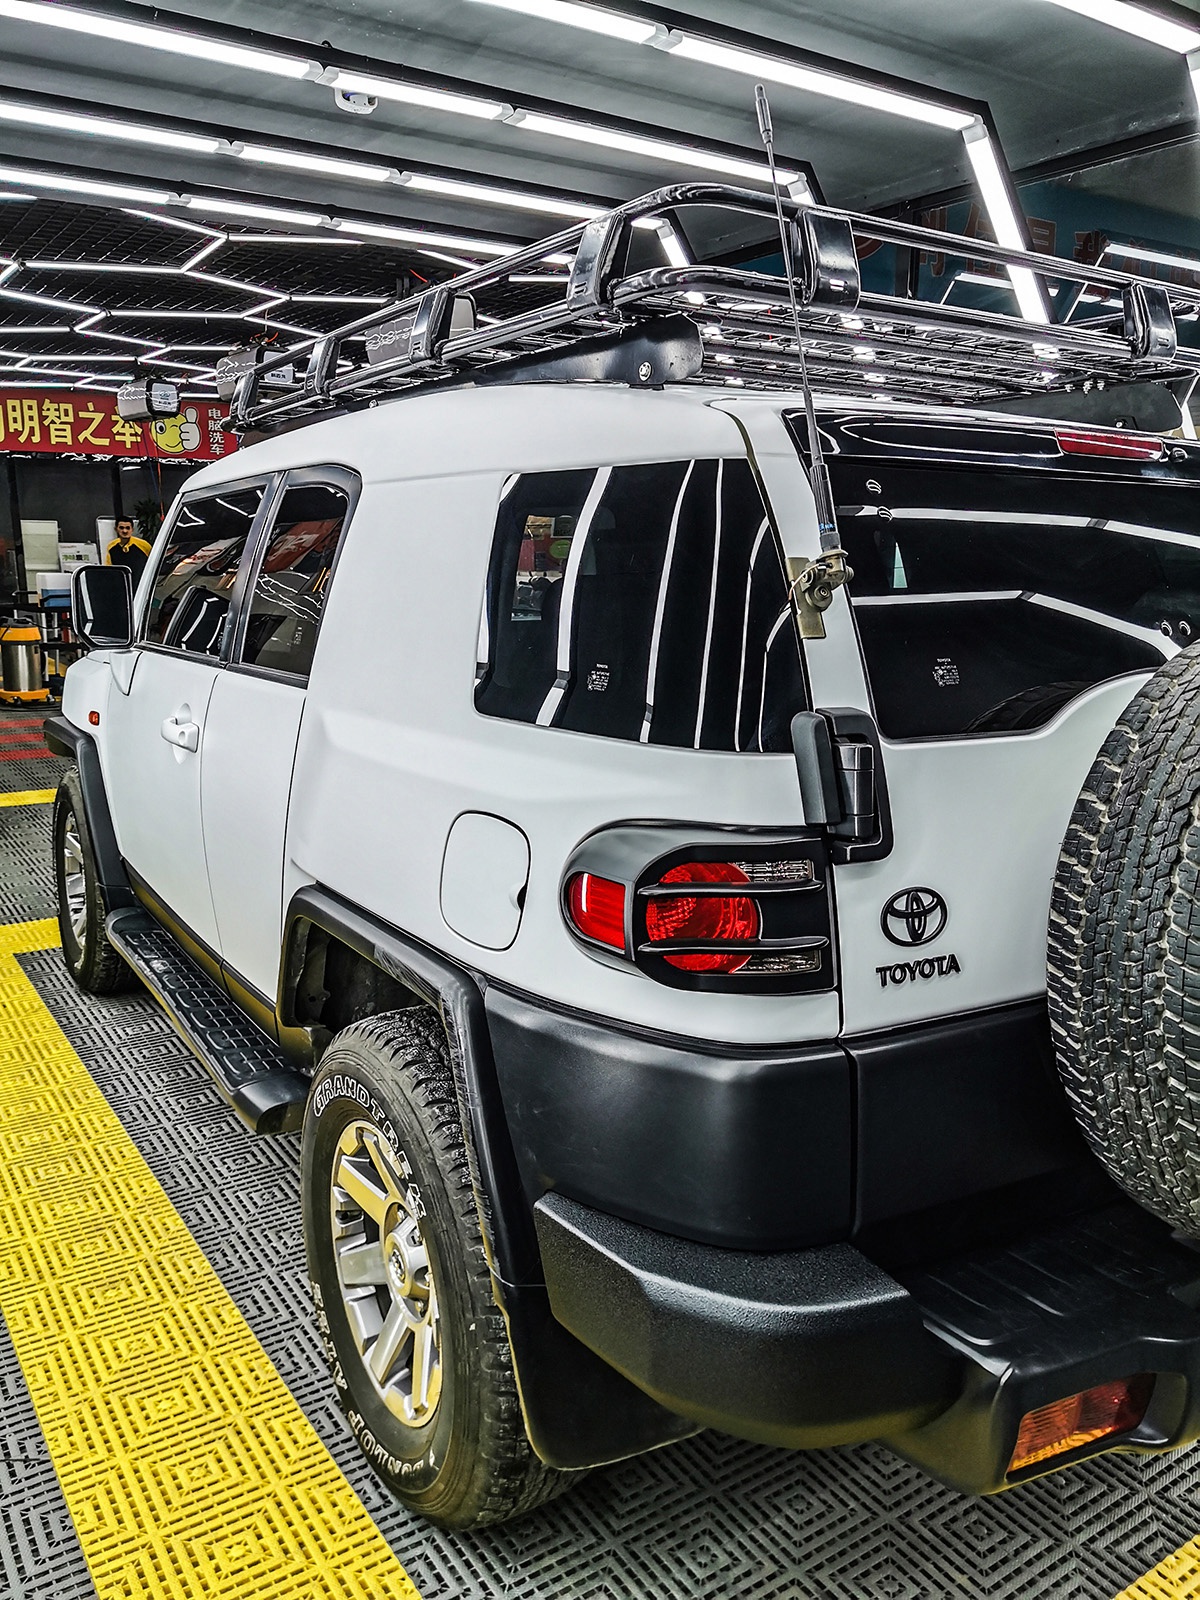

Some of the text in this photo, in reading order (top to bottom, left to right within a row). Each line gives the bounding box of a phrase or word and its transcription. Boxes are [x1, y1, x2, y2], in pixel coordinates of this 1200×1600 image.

[0, 399, 143, 449] 明智之举
[208, 407, 225, 455] 电脑洗车
[875, 954, 962, 988] TOYOTA
